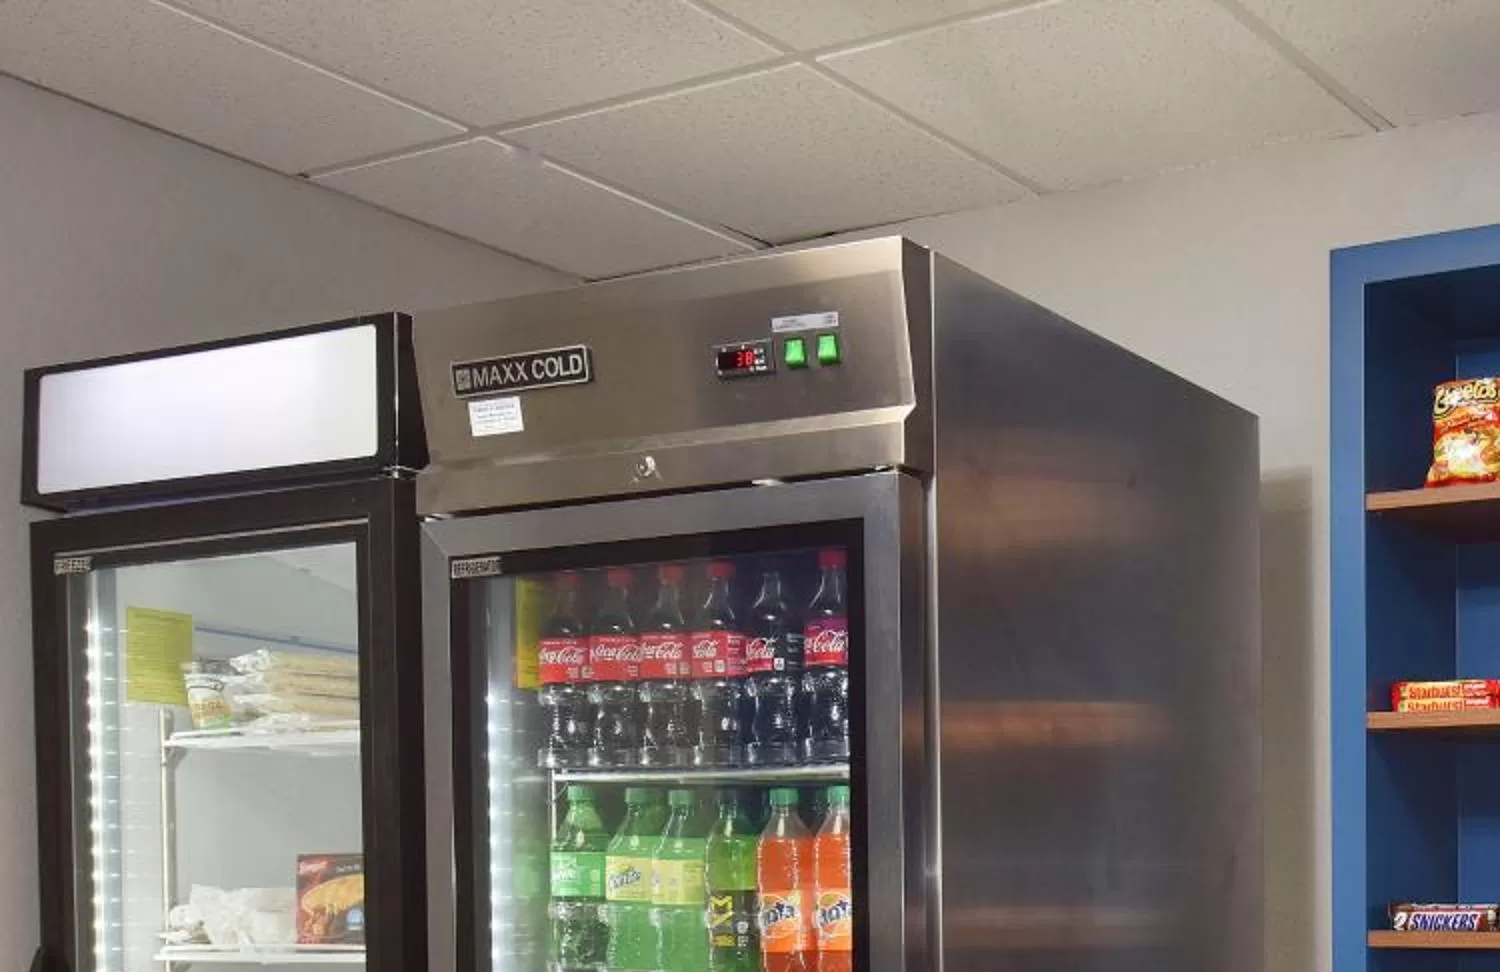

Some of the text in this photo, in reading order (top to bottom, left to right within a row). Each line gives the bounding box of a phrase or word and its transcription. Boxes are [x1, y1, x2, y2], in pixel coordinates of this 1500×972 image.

[472, 352, 583, 389] MAXX COLD
[1410, 912, 1479, 931] SNICKERS
